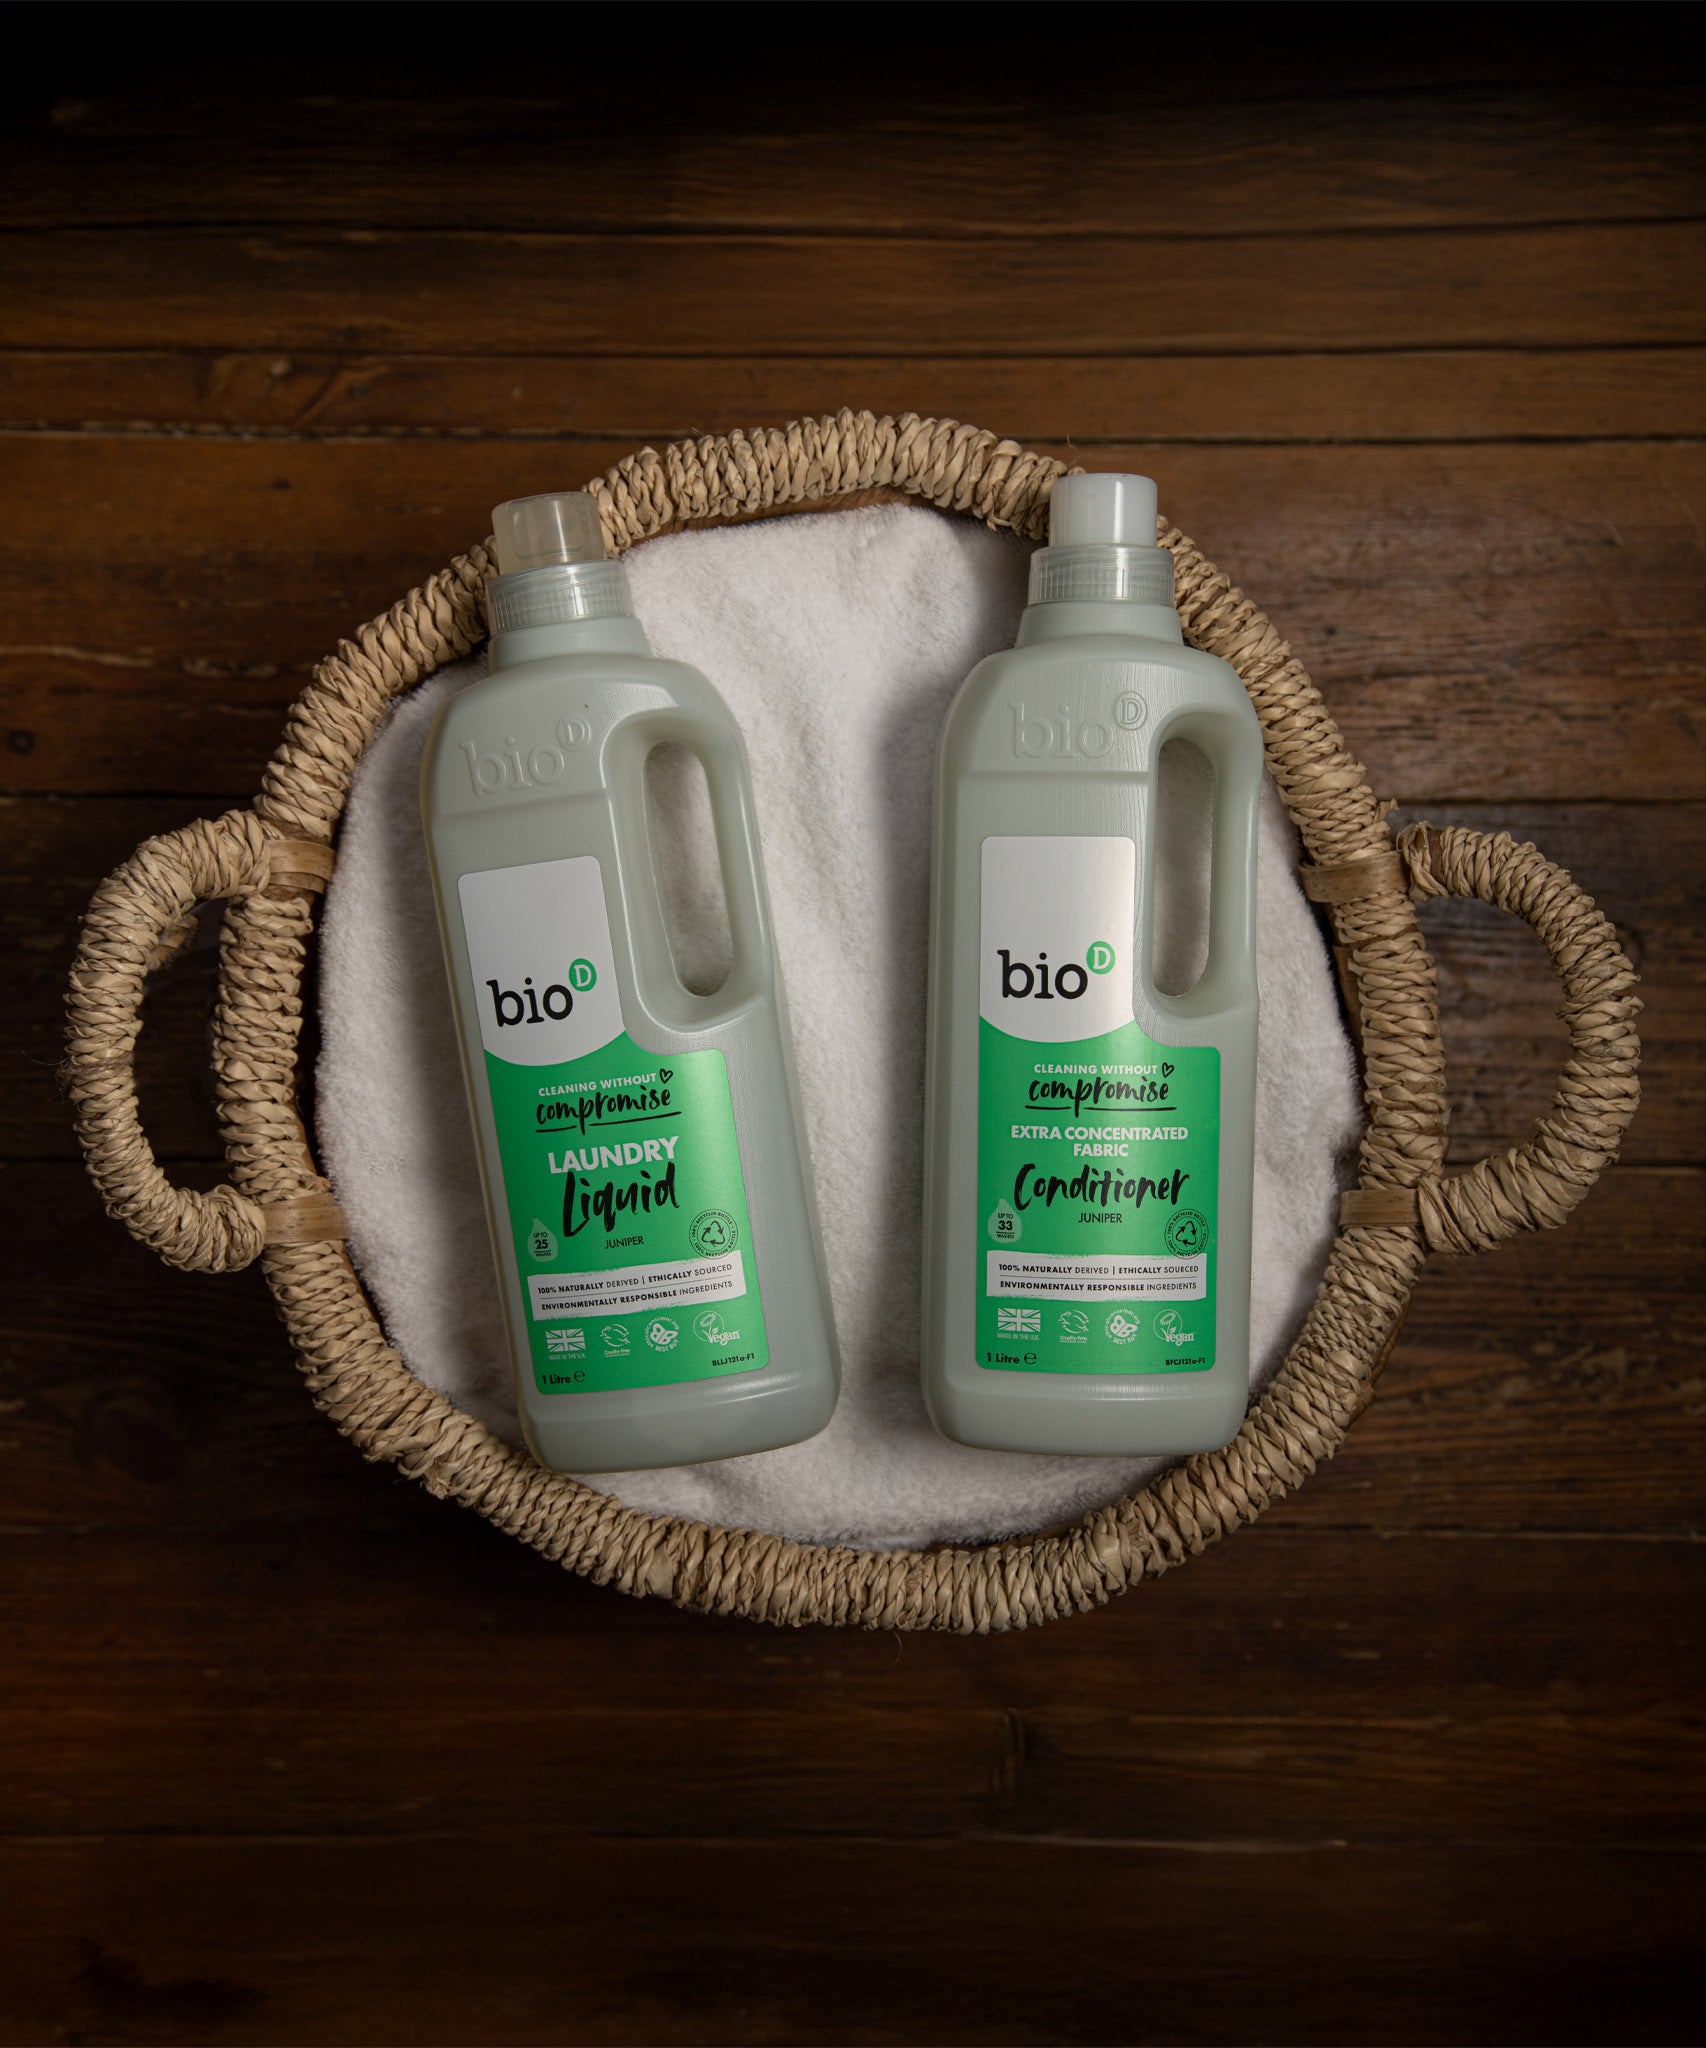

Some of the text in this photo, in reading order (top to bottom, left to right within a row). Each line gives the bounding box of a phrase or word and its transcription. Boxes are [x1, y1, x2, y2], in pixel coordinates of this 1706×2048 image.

[458, 736, 564, 796] bio
[997, 944, 1112, 999] bio D
[486, 961, 594, 1028] bio D
[1034, 1064, 1158, 1075] CLEANING WITHOUT
[538, 1073, 657, 1097] CLEANING WITHOUT
[1028, 1076, 1169, 1118] compromise
[536, 1085, 671, 1135] compromise
[1011, 1125, 1189, 1141] EXTRA CONCENTRATED
[548, 1136, 679, 1174] LAUNDRY
[1073, 1143, 1129, 1157] FABRIC
[1013, 1163, 1190, 1211] Conditioner
[563, 1161, 680, 1237] Liquid
[998, 1220, 1013, 1231] 33
[1078, 1212, 1123, 1223] JUNIPER
[534, 1239, 549, 1250] 25
[604, 1236, 645, 1250] JUNIPER
[998, 1264, 1199, 1275] 100% NATURALLY DERIVED ETHICALLY SOURCED
[538, 1264, 733, 1294] 100% NATURALLY DERIVED ETHICALLY SOURCED
[1000, 1281, 1085, 1291] ENVIRONMENTALLY
[1146, 1282, 1197, 1291] INGREDIENTS
[541, 1281, 733, 1311] ENVIRONMENTALLY RESPONSIBLE INGREDIENTS
[702, 1330, 740, 1346] Vegan
[1162, 1329, 1195, 1346] Vegan
[987, 1352, 992, 1362] 1
[995, 1353, 1020, 1364] Litre
[542, 1374, 547, 1384] 1
[549, 1374, 571, 1385] Litre
